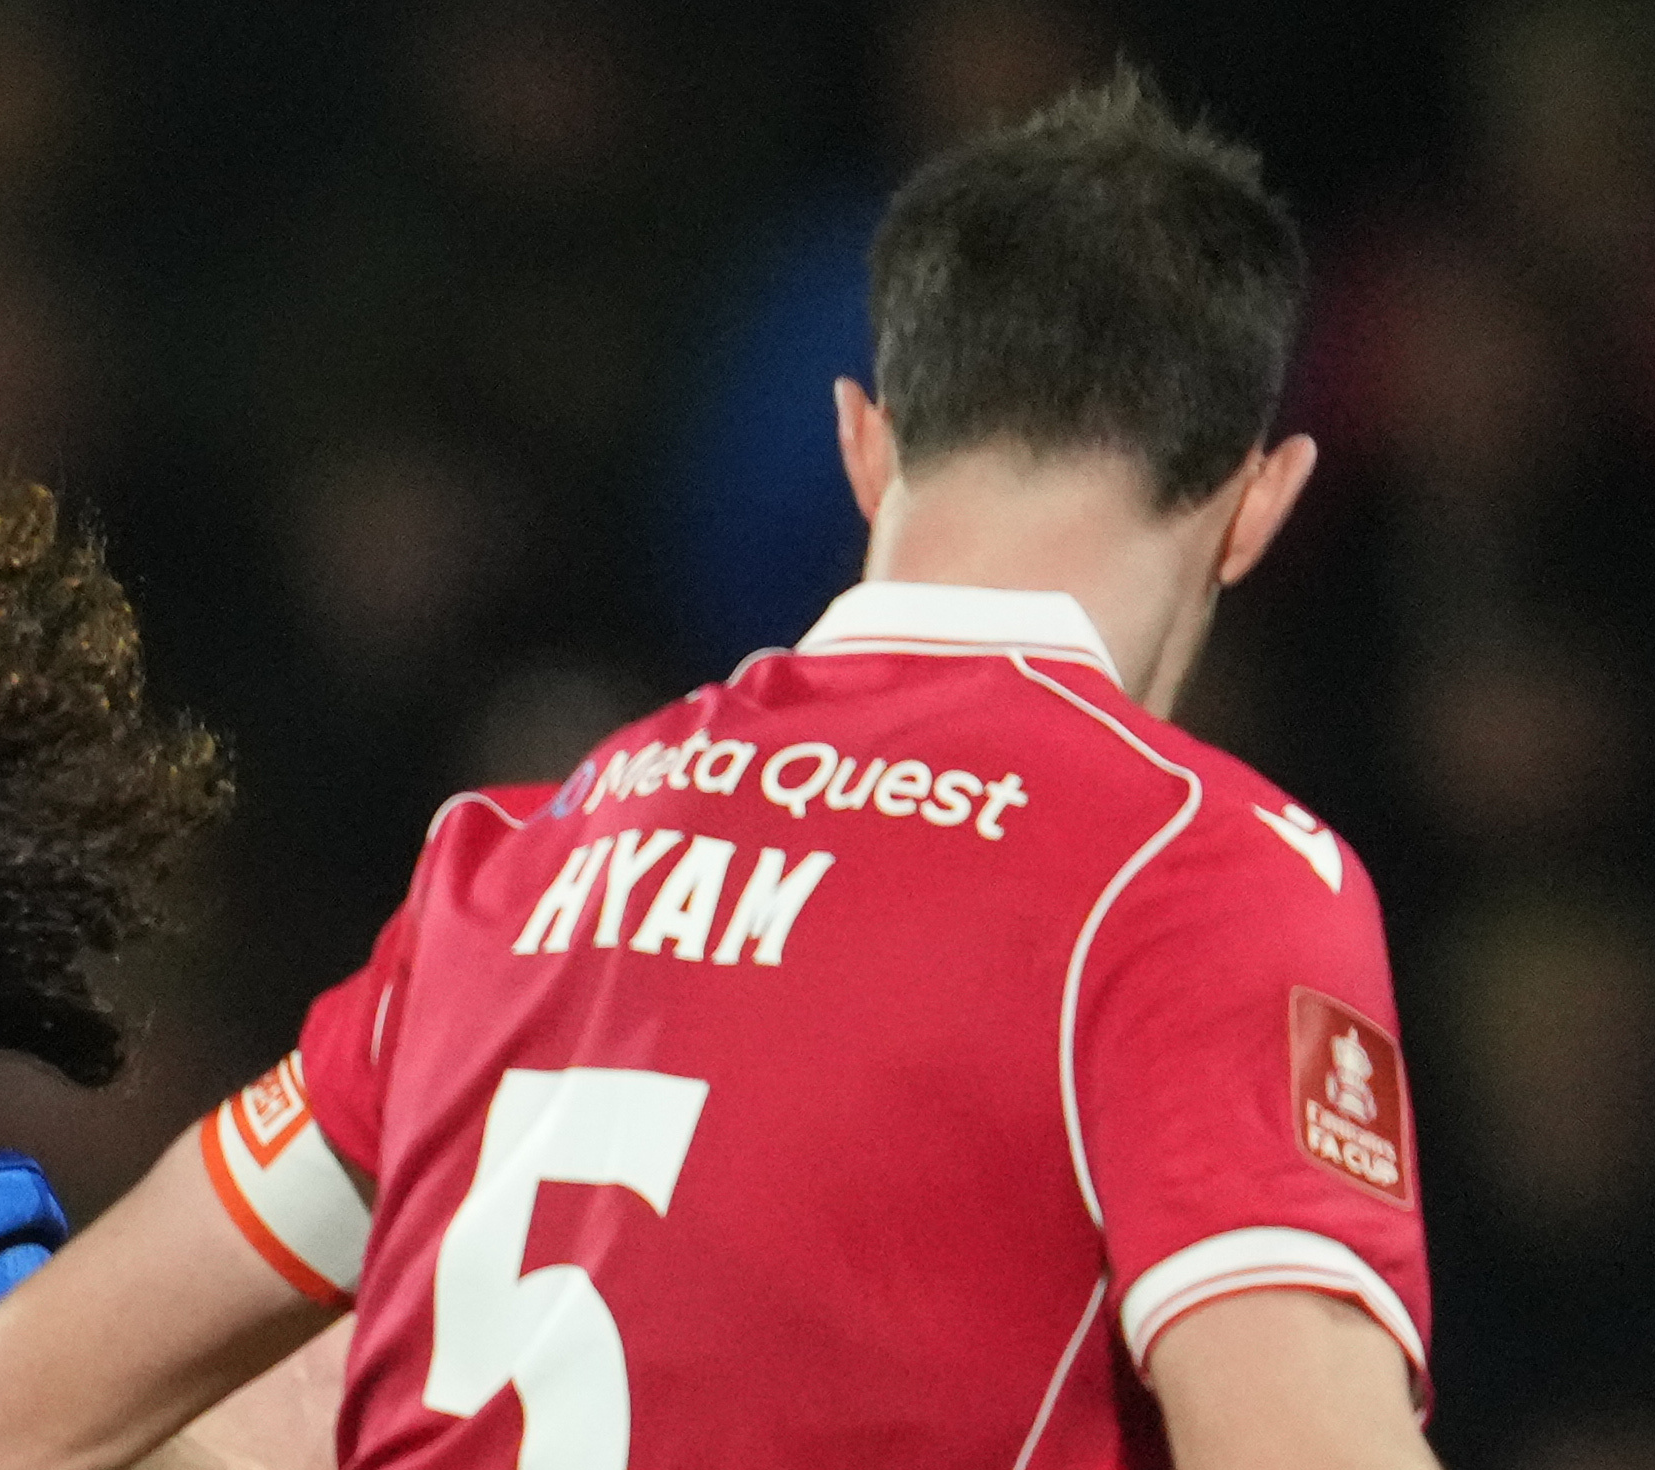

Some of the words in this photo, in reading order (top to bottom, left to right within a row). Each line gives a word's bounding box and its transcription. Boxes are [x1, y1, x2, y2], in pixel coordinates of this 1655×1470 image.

[581, 727, 758, 816] Meta
[761, 741, 1030, 841] Quest
[510, 827, 836, 967] HYAM
